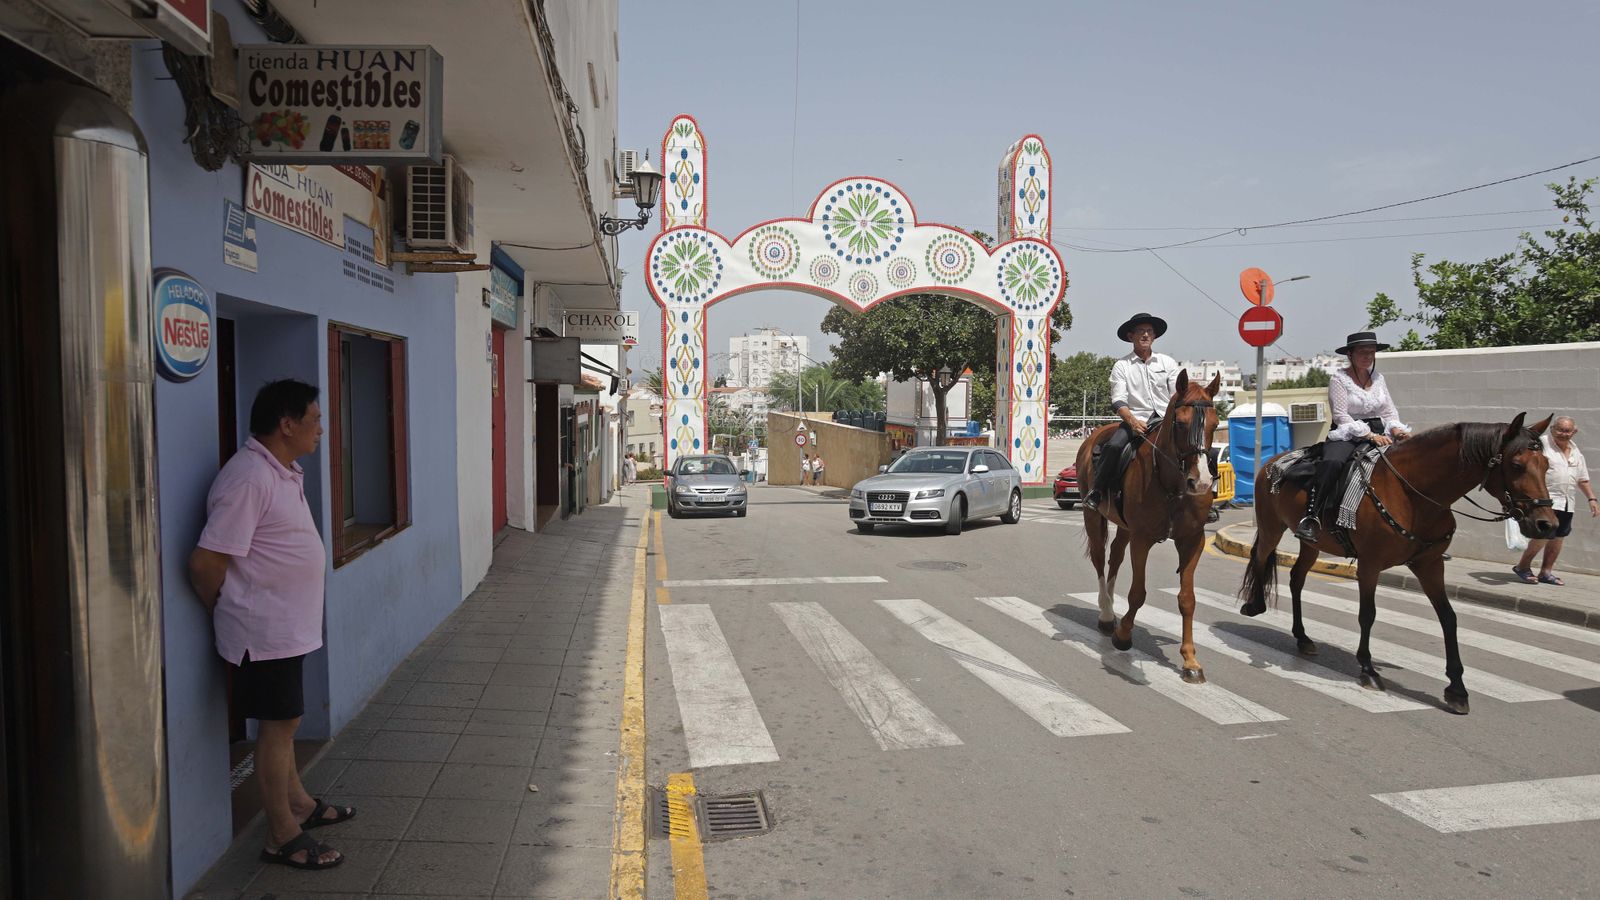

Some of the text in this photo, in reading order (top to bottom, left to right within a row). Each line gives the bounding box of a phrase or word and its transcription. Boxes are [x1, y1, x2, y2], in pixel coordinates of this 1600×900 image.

[248, 50, 416, 71] tienda HUAN
[249, 70, 421, 108] Comestibles
[252, 171, 333, 241] Comestibles
[297, 173, 334, 208] HUAN
[167, 285, 204, 304] HELADOS
[164, 317, 209, 348] Nestlé
[567, 313, 636, 331] CHAROL
